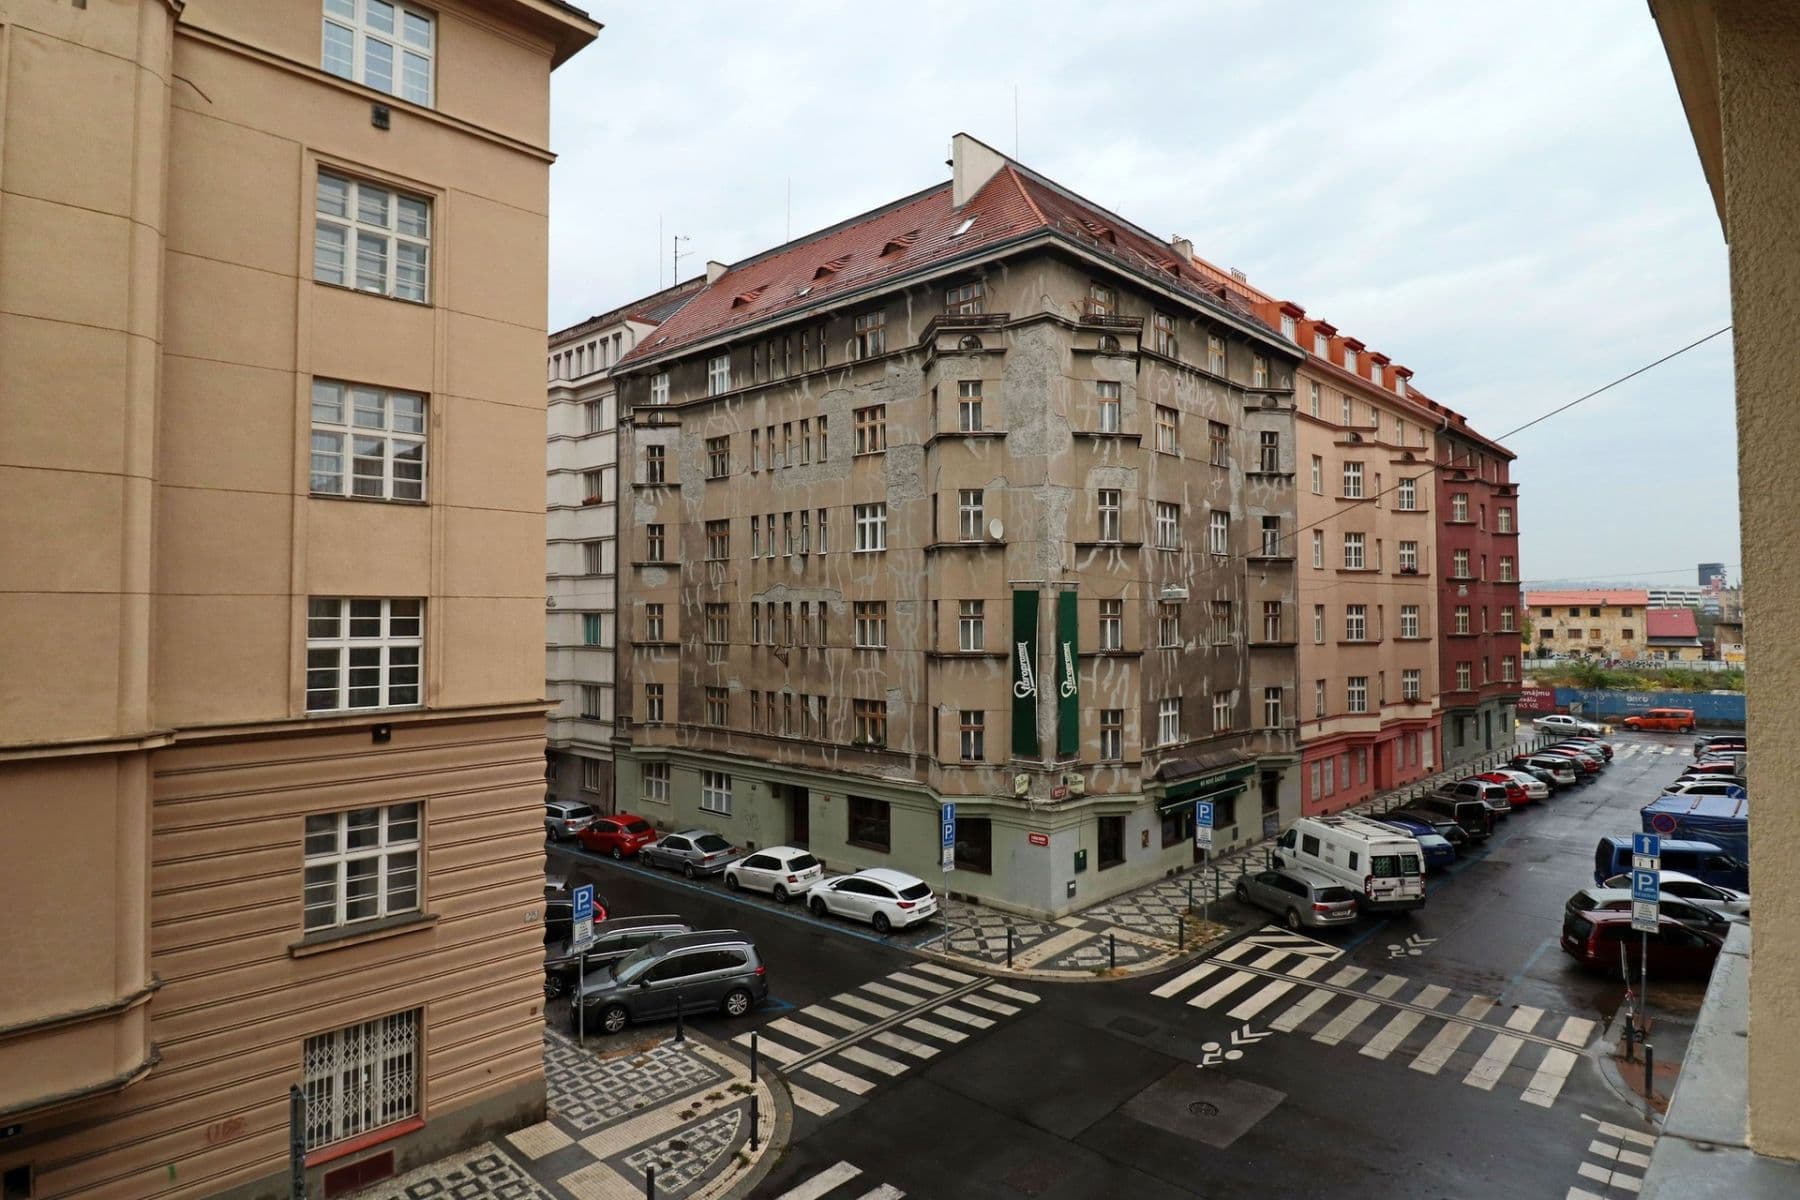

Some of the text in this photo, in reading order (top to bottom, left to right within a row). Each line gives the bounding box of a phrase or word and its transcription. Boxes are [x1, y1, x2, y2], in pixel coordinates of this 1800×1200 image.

[1014, 641, 1037, 698] Staropramen
[1061, 641, 1077, 698] Staropramen
[1200, 804, 1209, 818] P
[945, 824, 953, 840] P
[1638, 873, 1653, 891] P
[578, 891, 589, 911] P
